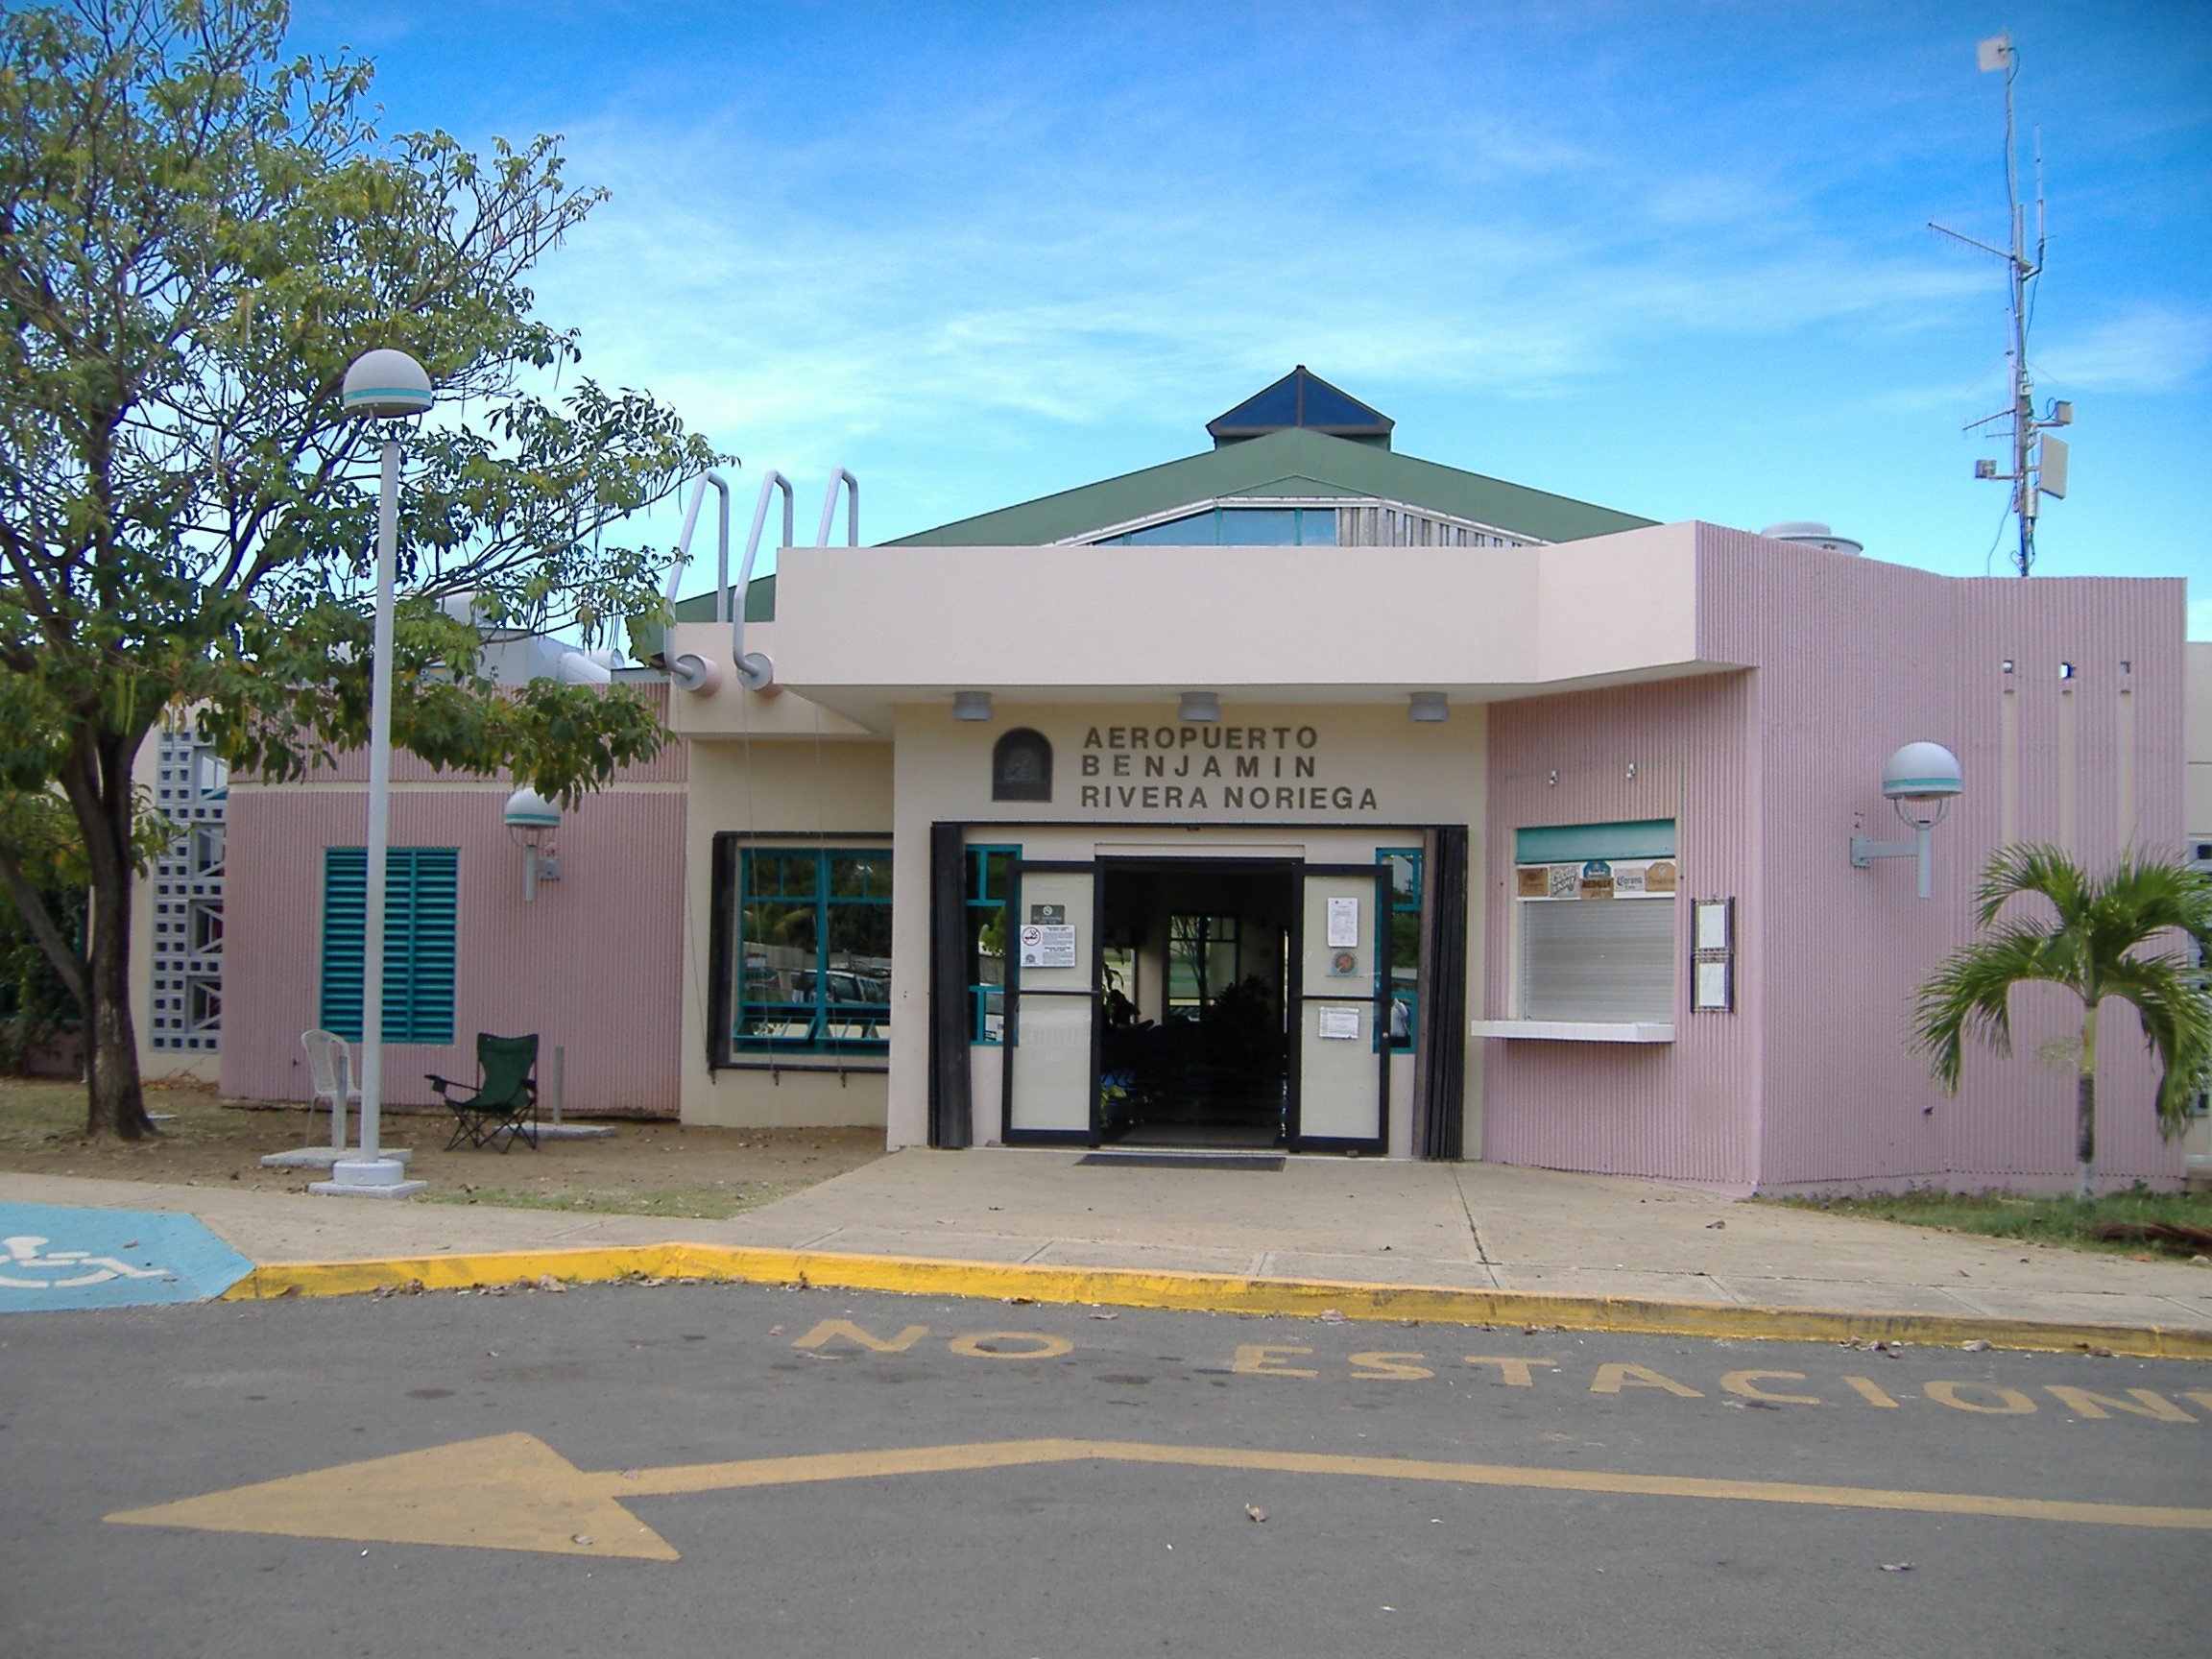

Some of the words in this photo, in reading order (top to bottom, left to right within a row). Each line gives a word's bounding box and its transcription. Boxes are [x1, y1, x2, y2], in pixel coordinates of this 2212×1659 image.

[1083, 726, 1318, 750] AEROPUERTO
[1082, 755, 1316, 778] BENJAMIN
[1081, 785, 1208, 808] RIVERA
[1224, 786, 1378, 810] NORIEGA
[790, 1318, 1074, 1359] NO
